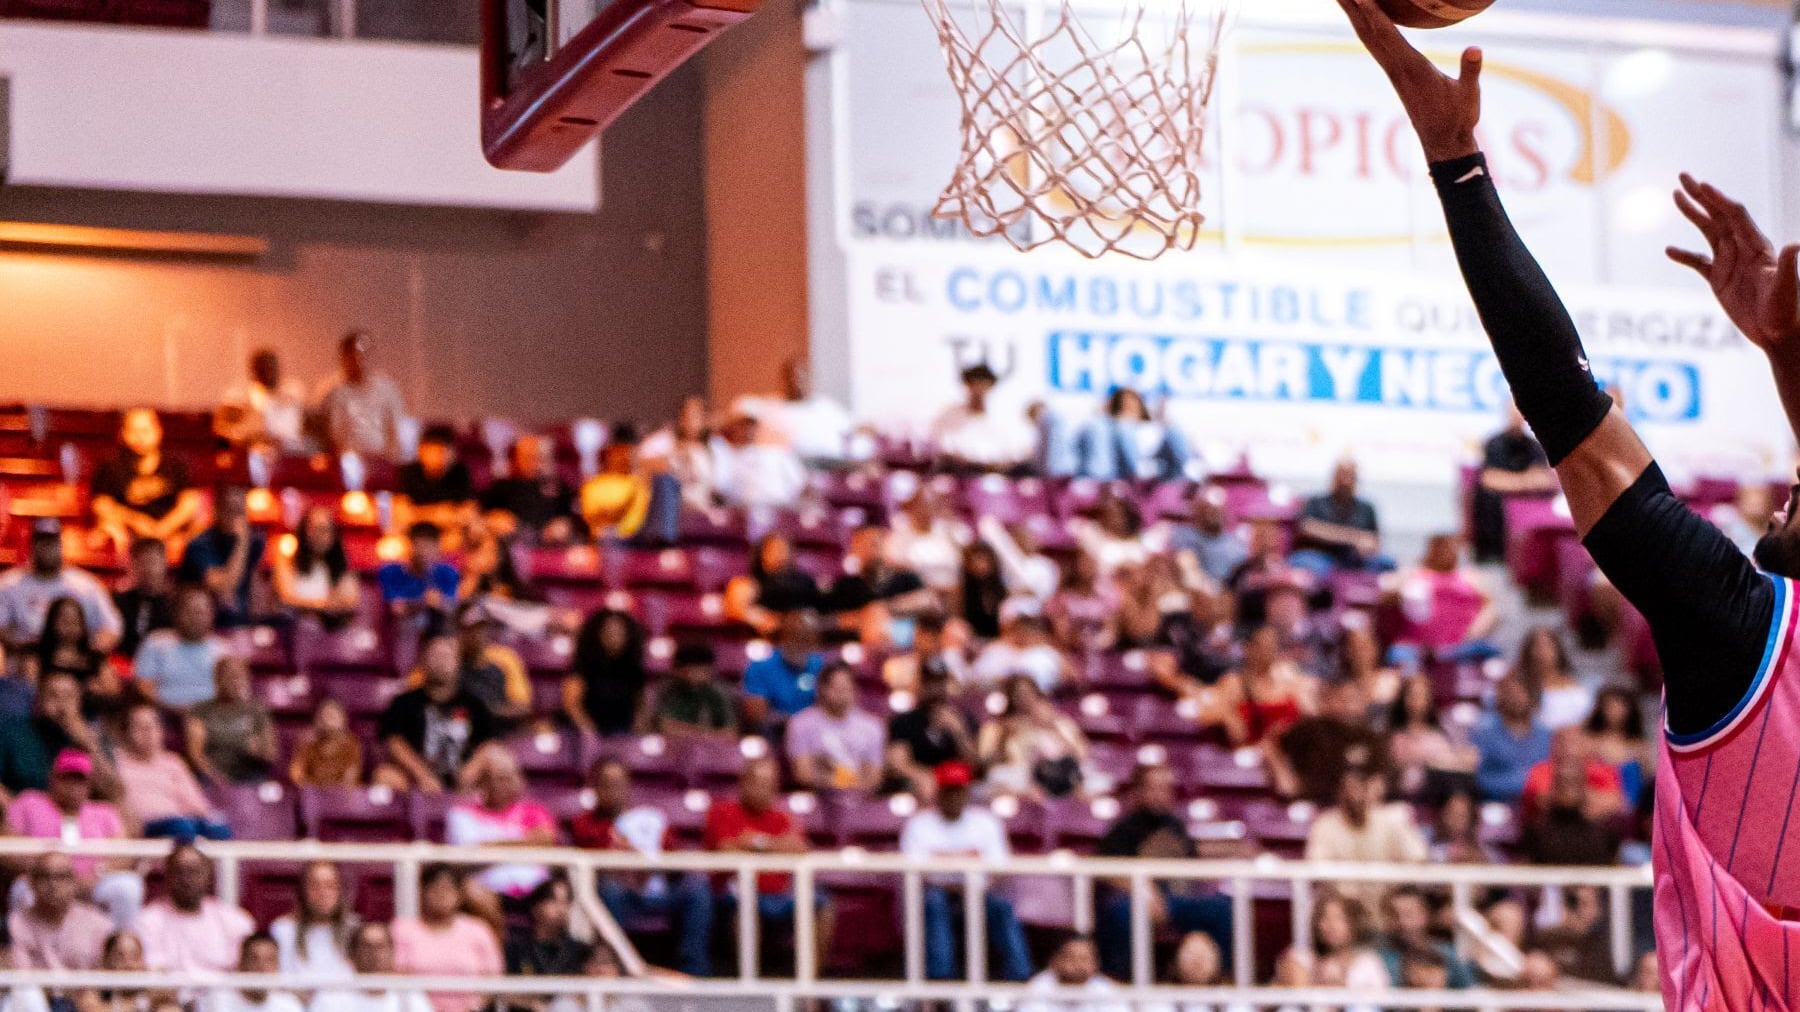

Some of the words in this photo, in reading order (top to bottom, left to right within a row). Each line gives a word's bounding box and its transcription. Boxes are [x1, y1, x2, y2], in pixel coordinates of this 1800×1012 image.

[875, 267, 926, 302] EL
[947, 266, 1373, 328] COMBUSTIBLE
[944, 334, 1016, 381] TU
[1057, 336, 1310, 402] HOGAR
[1319, 348, 1374, 401] Y
